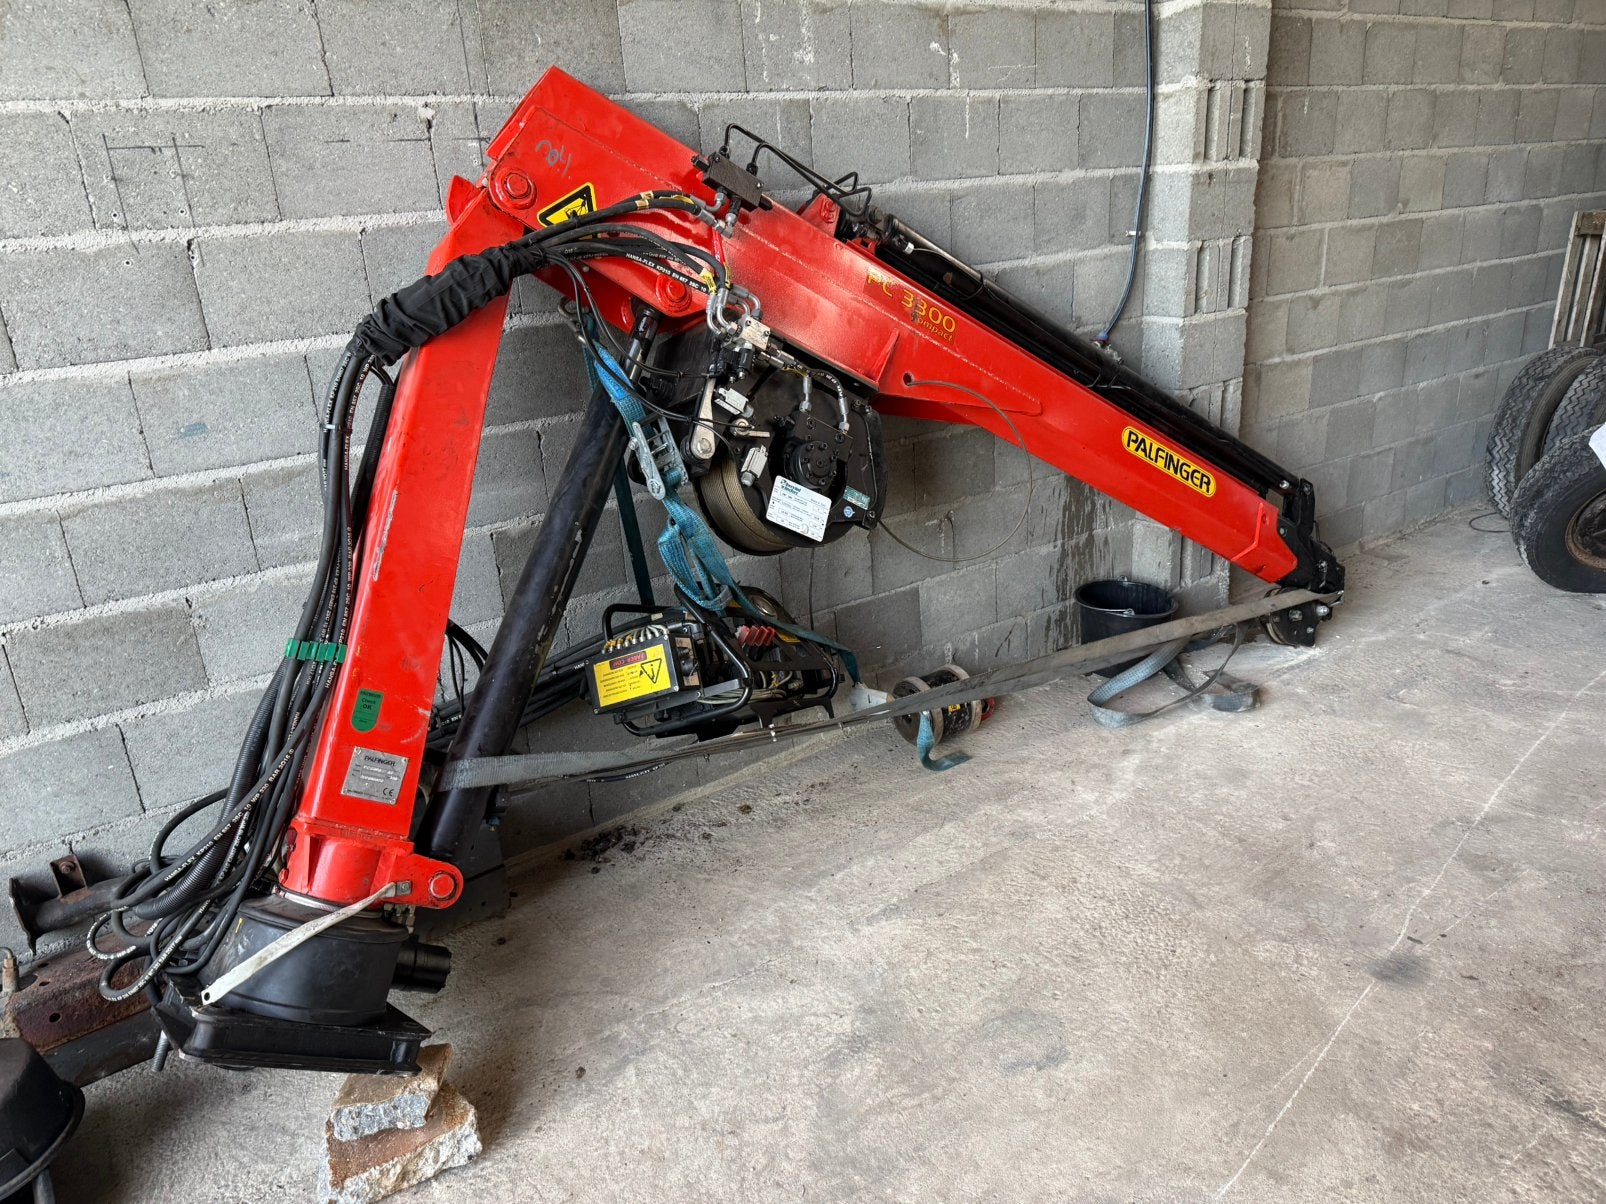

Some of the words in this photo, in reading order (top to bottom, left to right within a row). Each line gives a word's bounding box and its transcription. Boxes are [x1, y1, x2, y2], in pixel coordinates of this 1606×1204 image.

[625, 252, 655, 269] HANSA-FLEX
[867, 267, 893, 297] PC
[901, 288, 956, 333] 3300
[911, 311, 954, 342] ompact
[1126, 430, 1212, 493] PALFINGER
[164, 855, 196, 882] HANSA-FLEX
[213, 832, 223, 842] EN
[250, 792, 261, 803] WP
[268, 769, 280, 782] BAR
